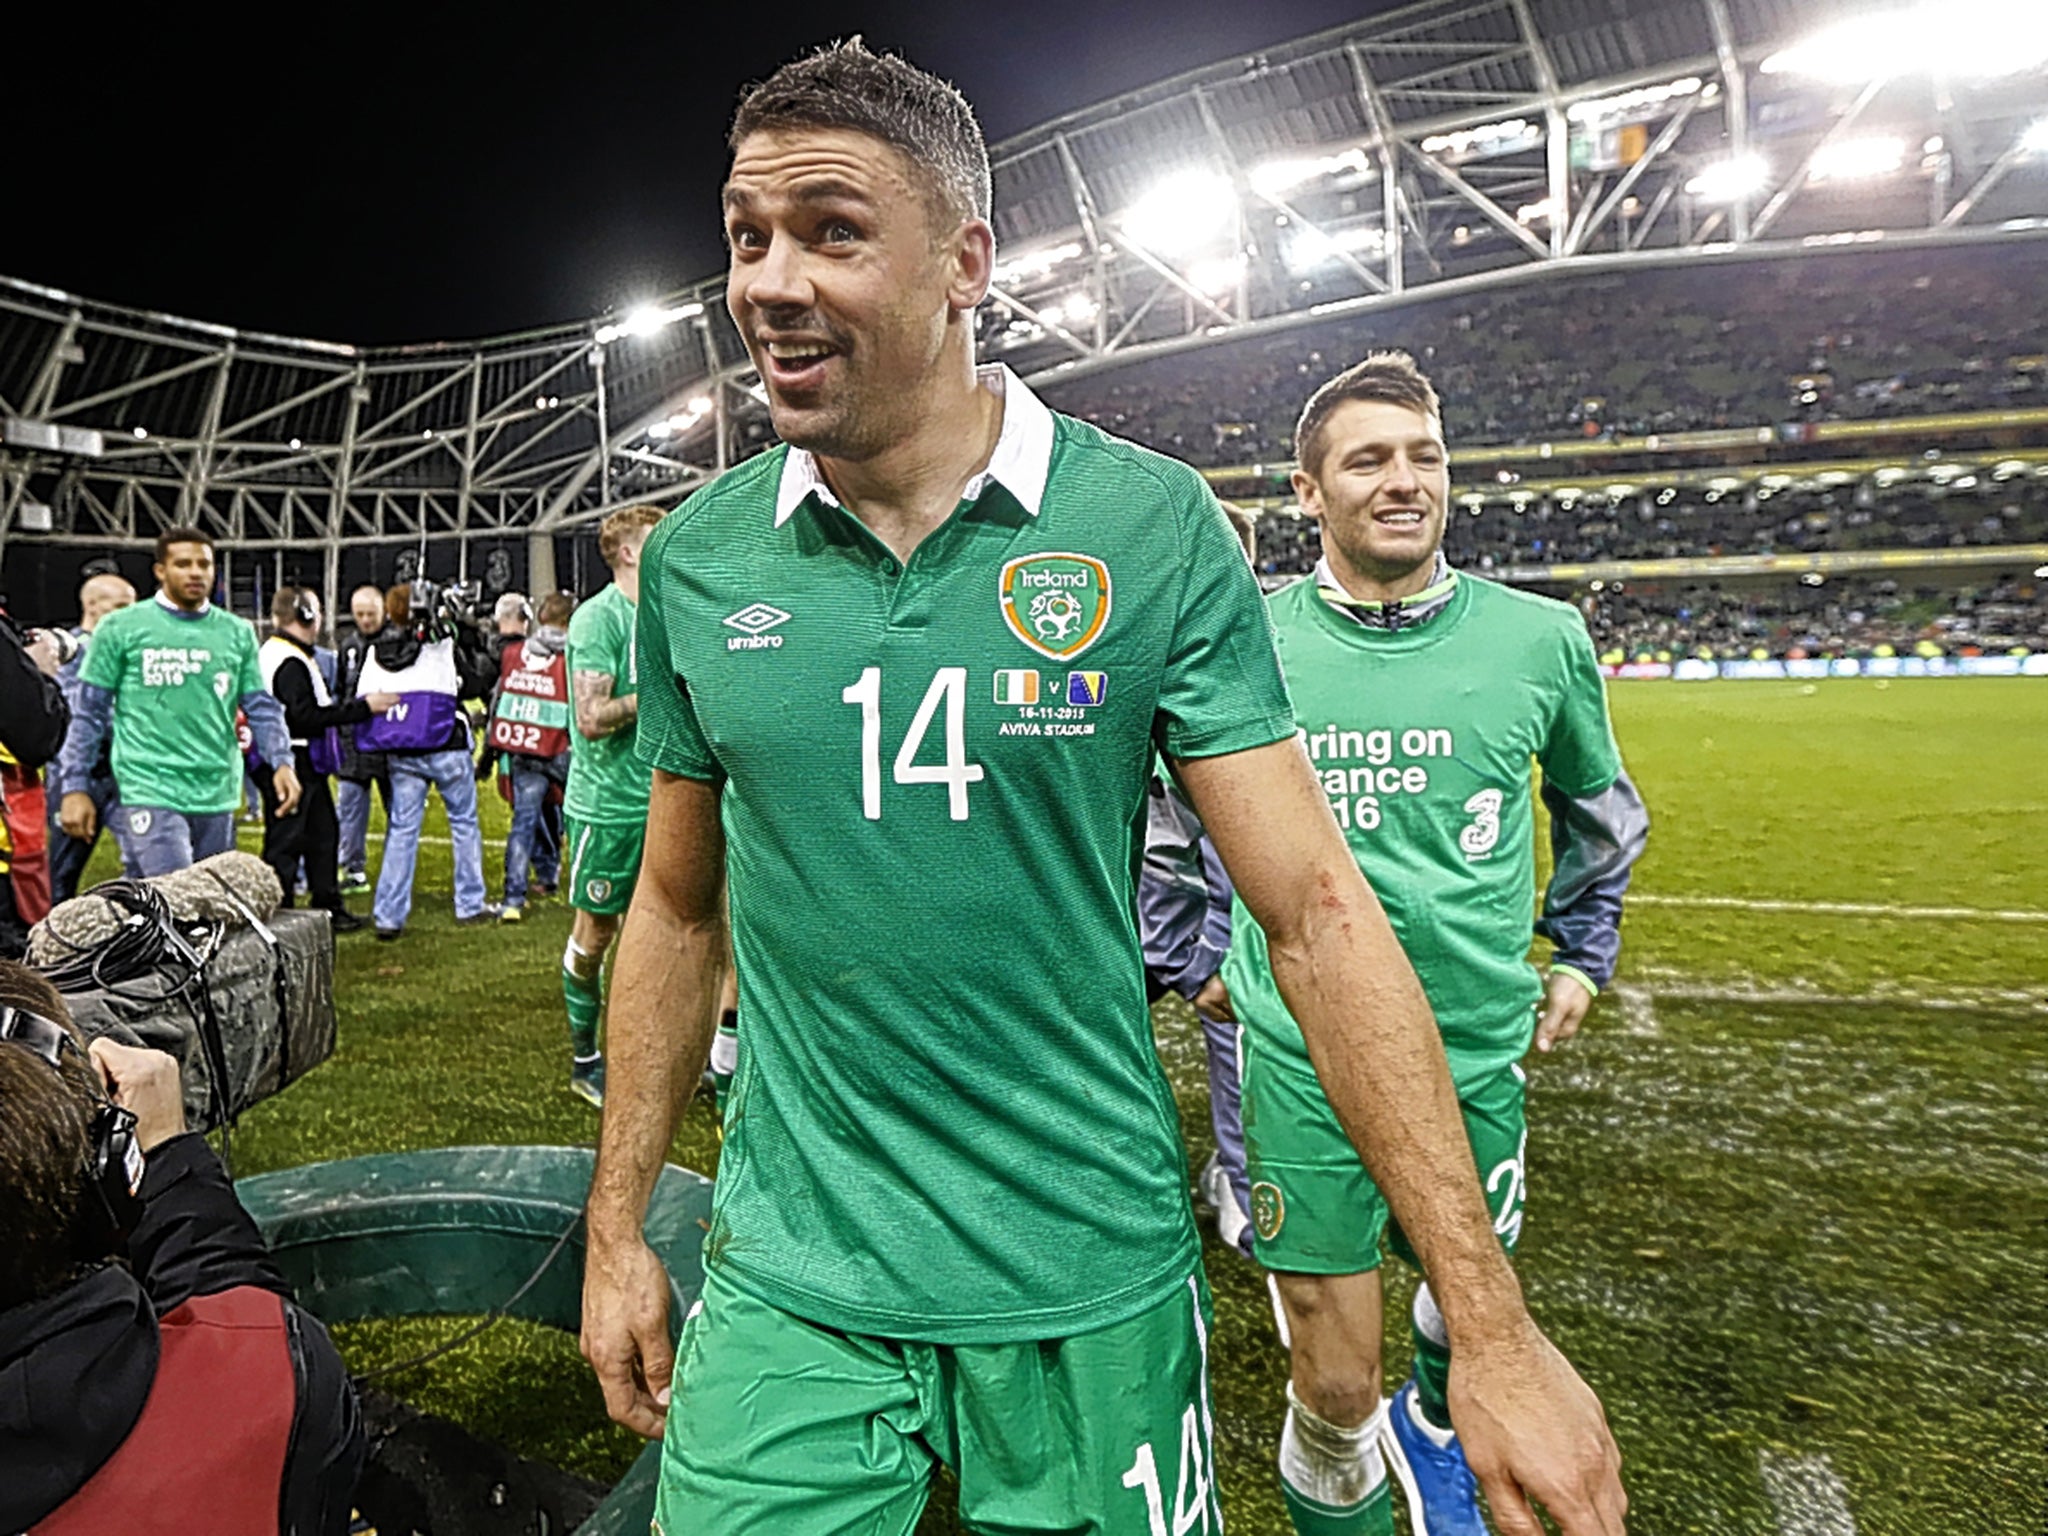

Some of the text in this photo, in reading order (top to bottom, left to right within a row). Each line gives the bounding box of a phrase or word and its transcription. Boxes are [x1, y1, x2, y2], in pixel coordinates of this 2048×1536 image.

[1019, 568, 1088, 588] Ireland
[727, 635, 784, 650] umbro
[1018, 706, 1086, 720] 16-11-2015
[495, 721, 541, 750] 032
[842, 667, 984, 820] 14
[998, 722, 1096, 736] AVIVA STADIUM
[1401, 728, 1453, 757] on
[1331, 796, 1382, 830] 16
[1122, 1402, 1209, 1536] 14
